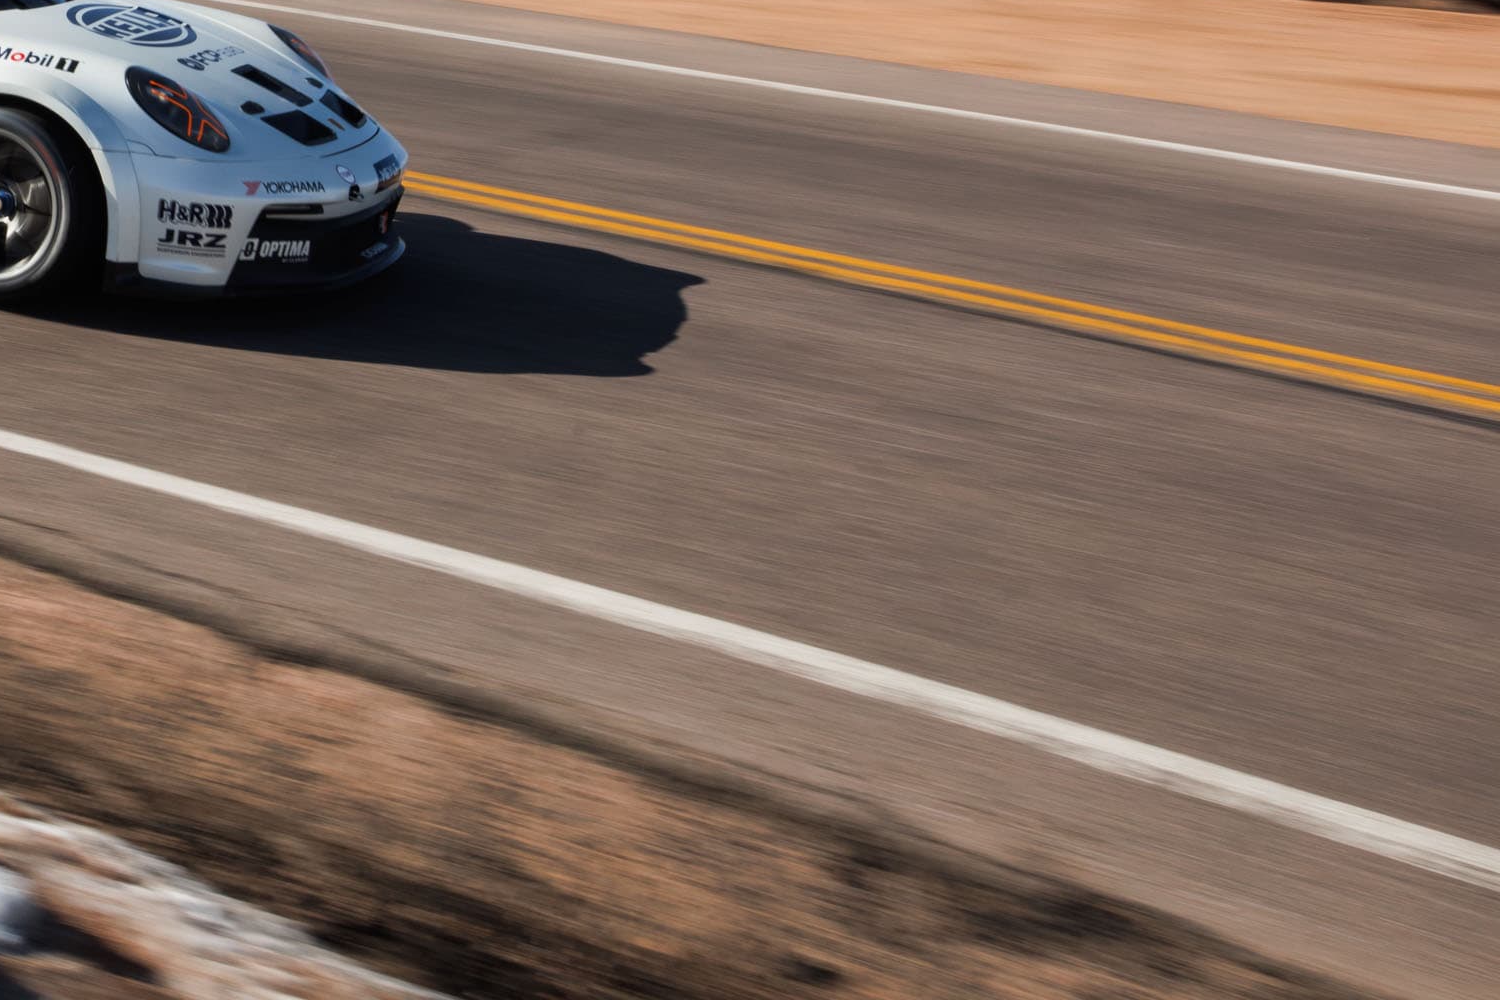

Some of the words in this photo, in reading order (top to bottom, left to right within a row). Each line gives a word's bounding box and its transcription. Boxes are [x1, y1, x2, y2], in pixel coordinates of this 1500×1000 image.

[263, 181, 325, 194] YOKOHAMA
[157, 198, 205, 226] H&R
[158, 228, 227, 249] JRZ
[259, 240, 311, 259] OPTIMA
